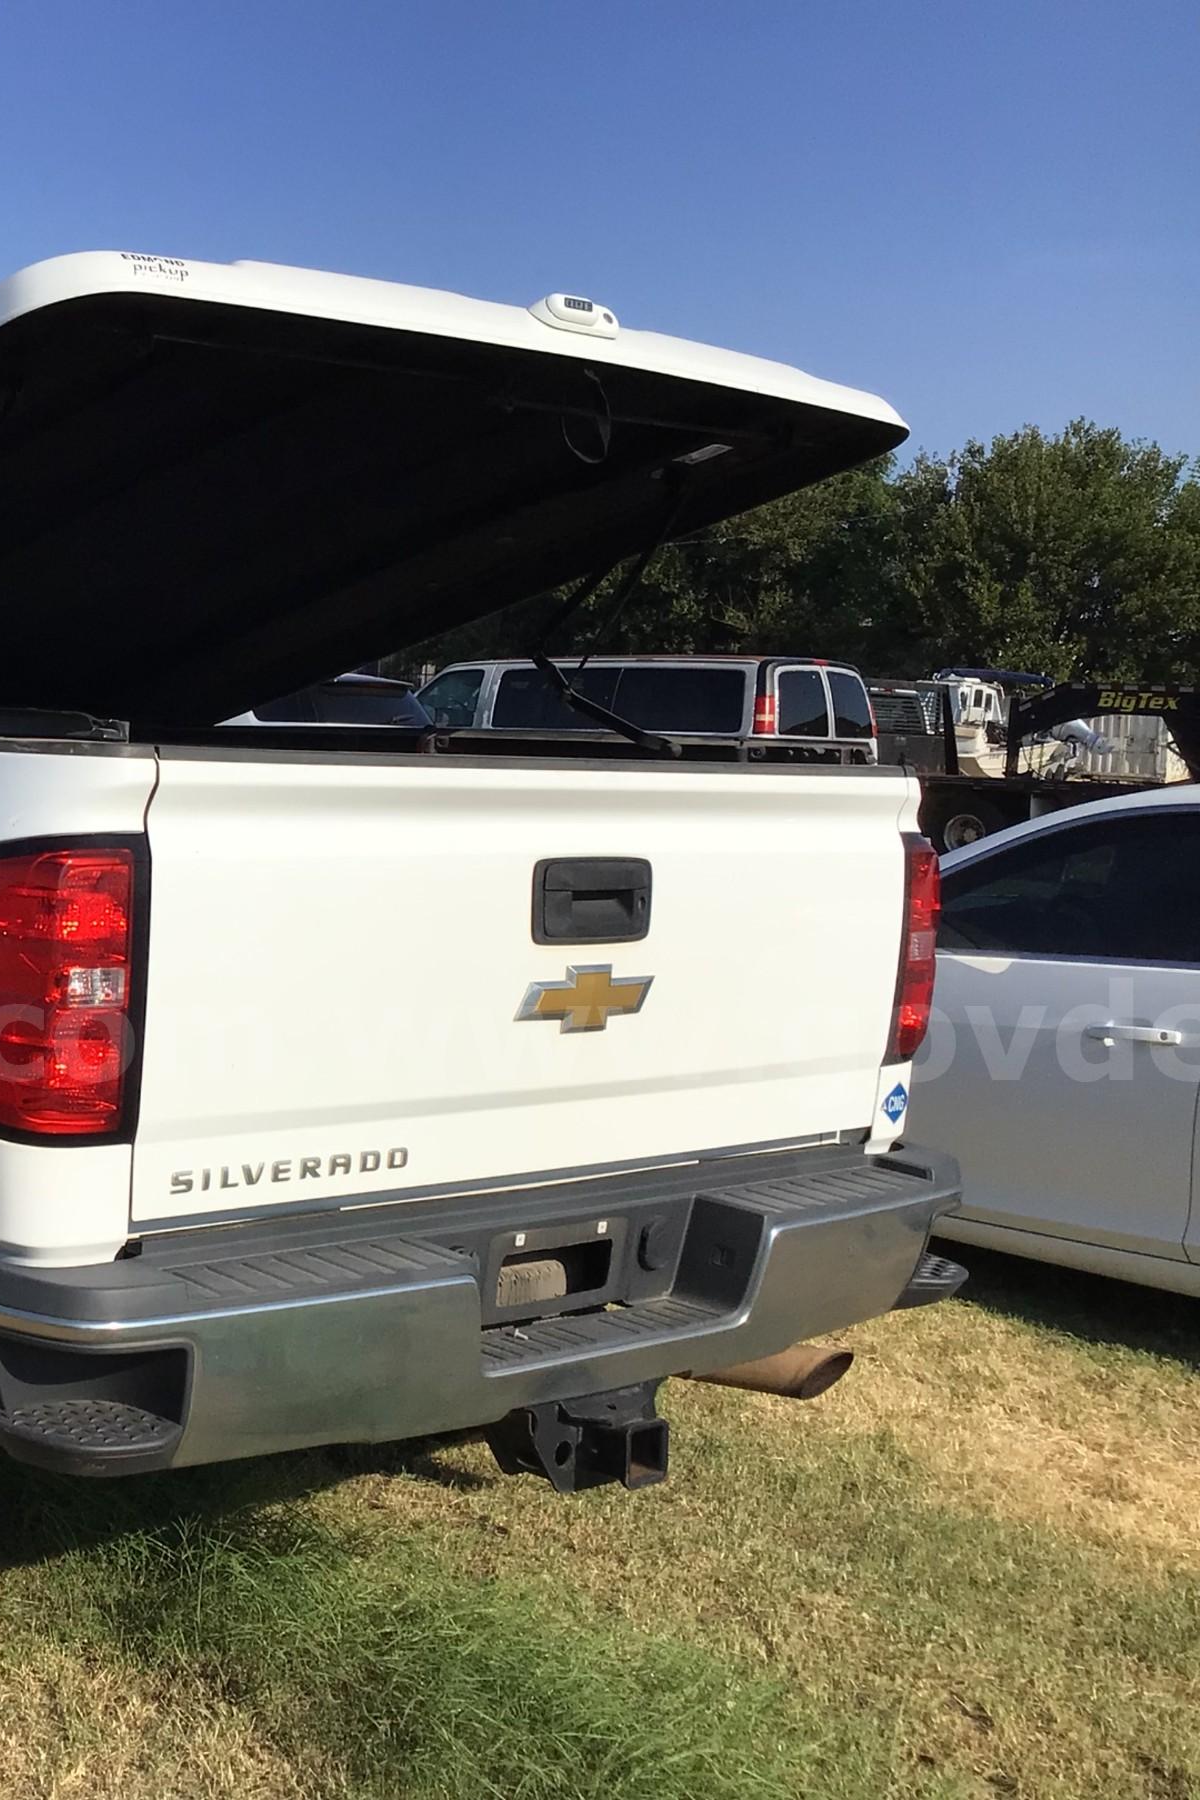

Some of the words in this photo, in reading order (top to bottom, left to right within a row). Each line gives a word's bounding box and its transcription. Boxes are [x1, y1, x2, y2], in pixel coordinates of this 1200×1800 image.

[133, 263, 189, 282] pickup
[1097, 690, 1182, 712] BigTex
[888, 1094, 906, 1113] CNG
[169, 1146, 409, 1195] SILVERADO
